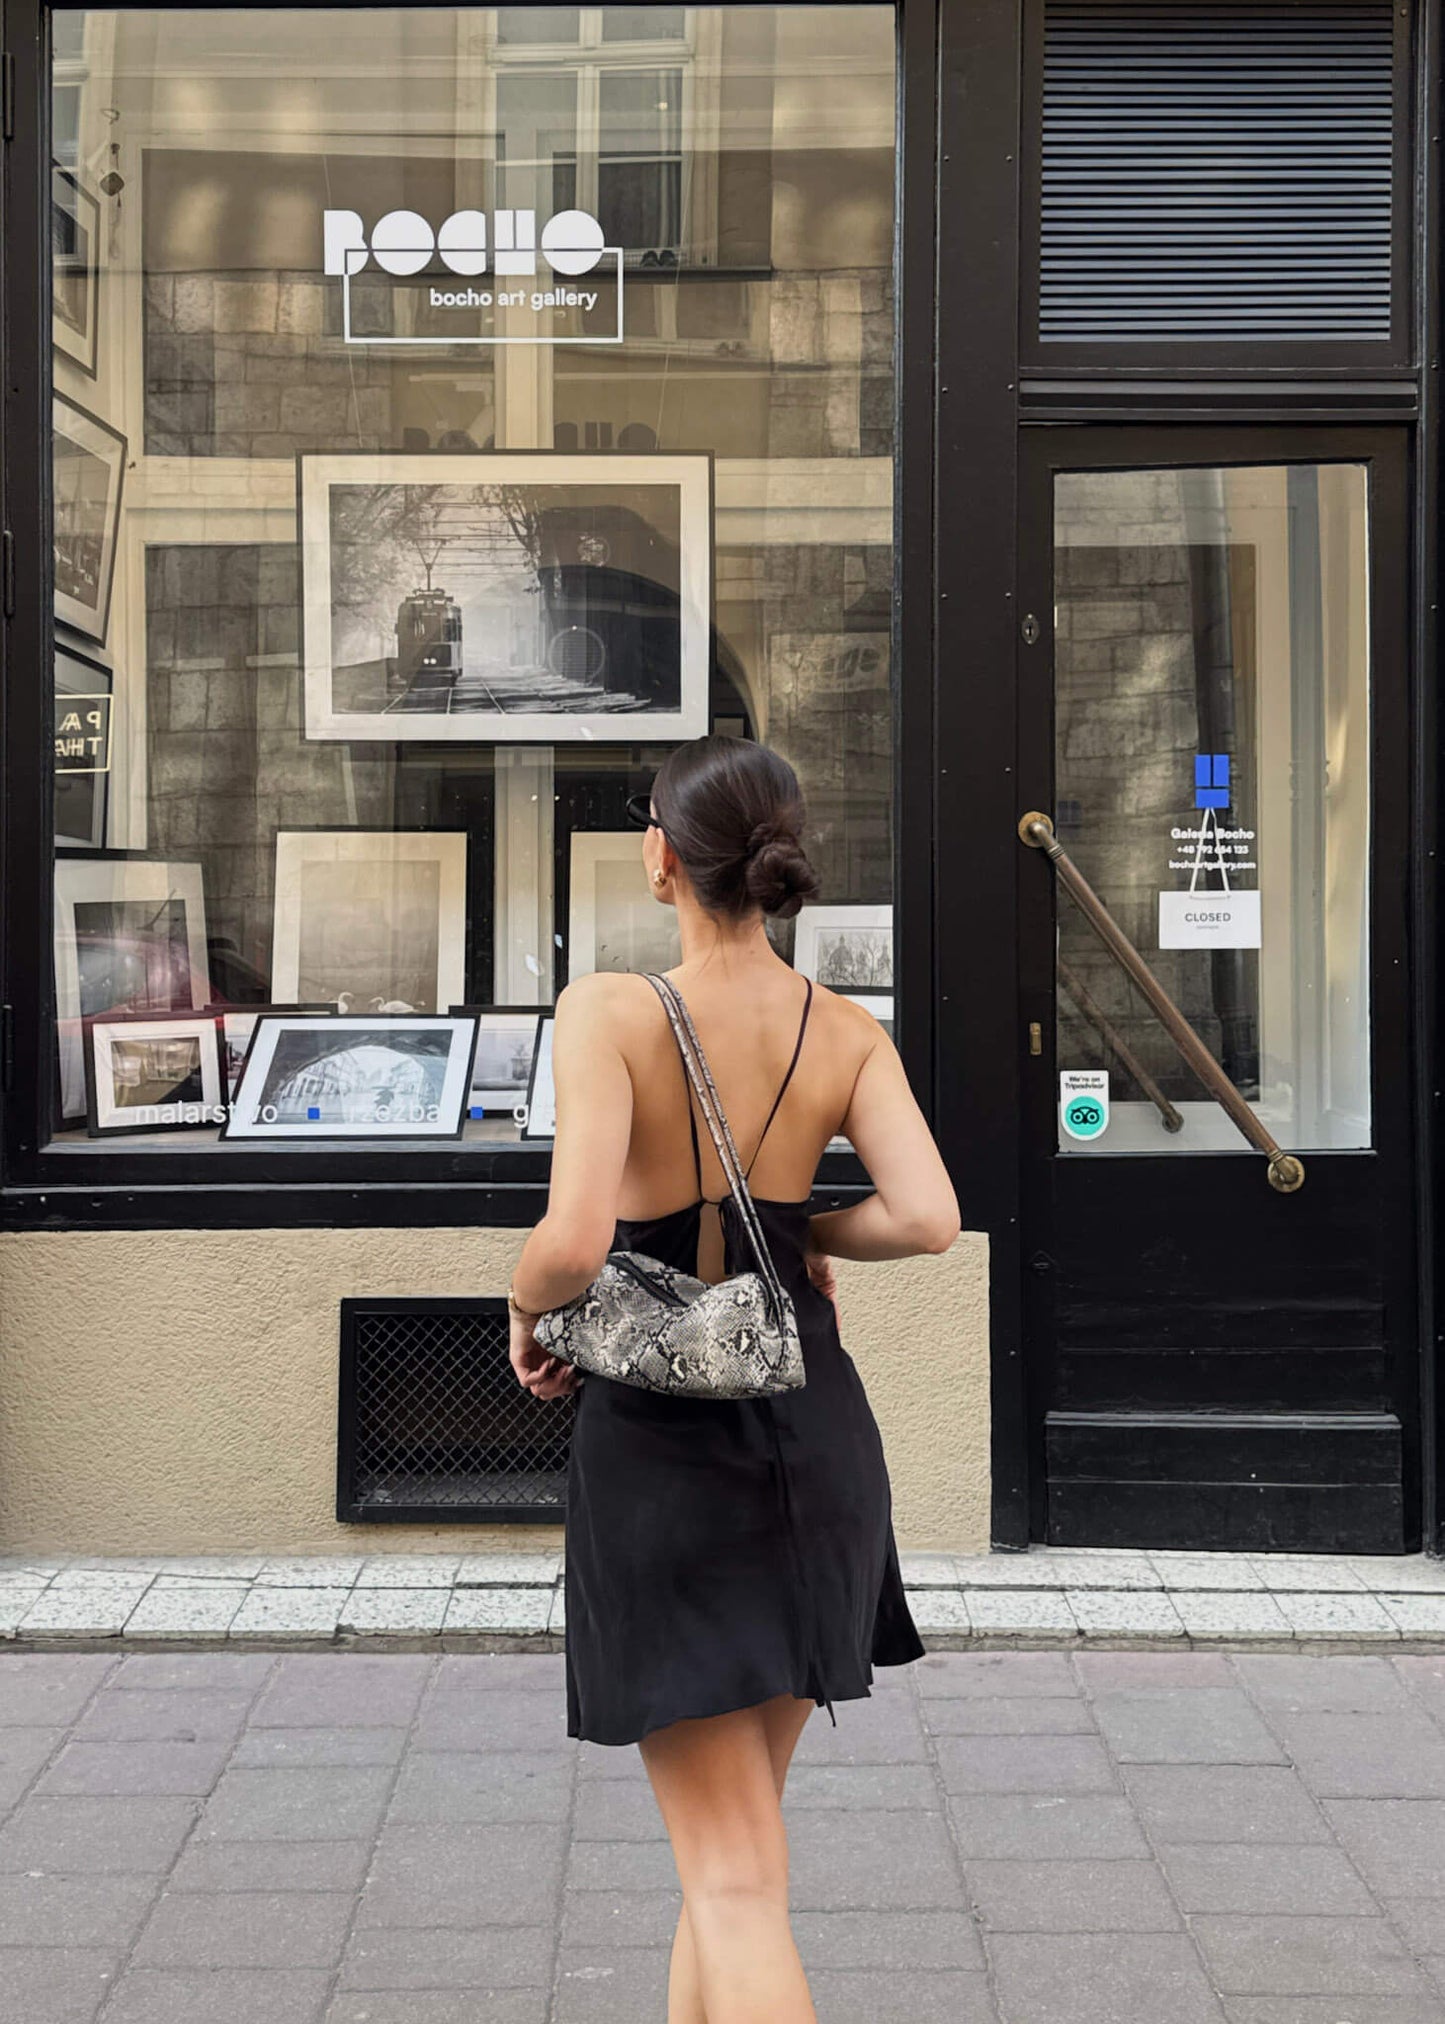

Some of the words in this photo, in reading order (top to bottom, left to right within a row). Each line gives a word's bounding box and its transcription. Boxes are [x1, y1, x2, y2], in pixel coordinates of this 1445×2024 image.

[429, 287, 493, 307] bocho
[497, 289, 526, 307] art
[530, 287, 598, 312] gallery
[1185, 912, 1231, 922] CLOSED
